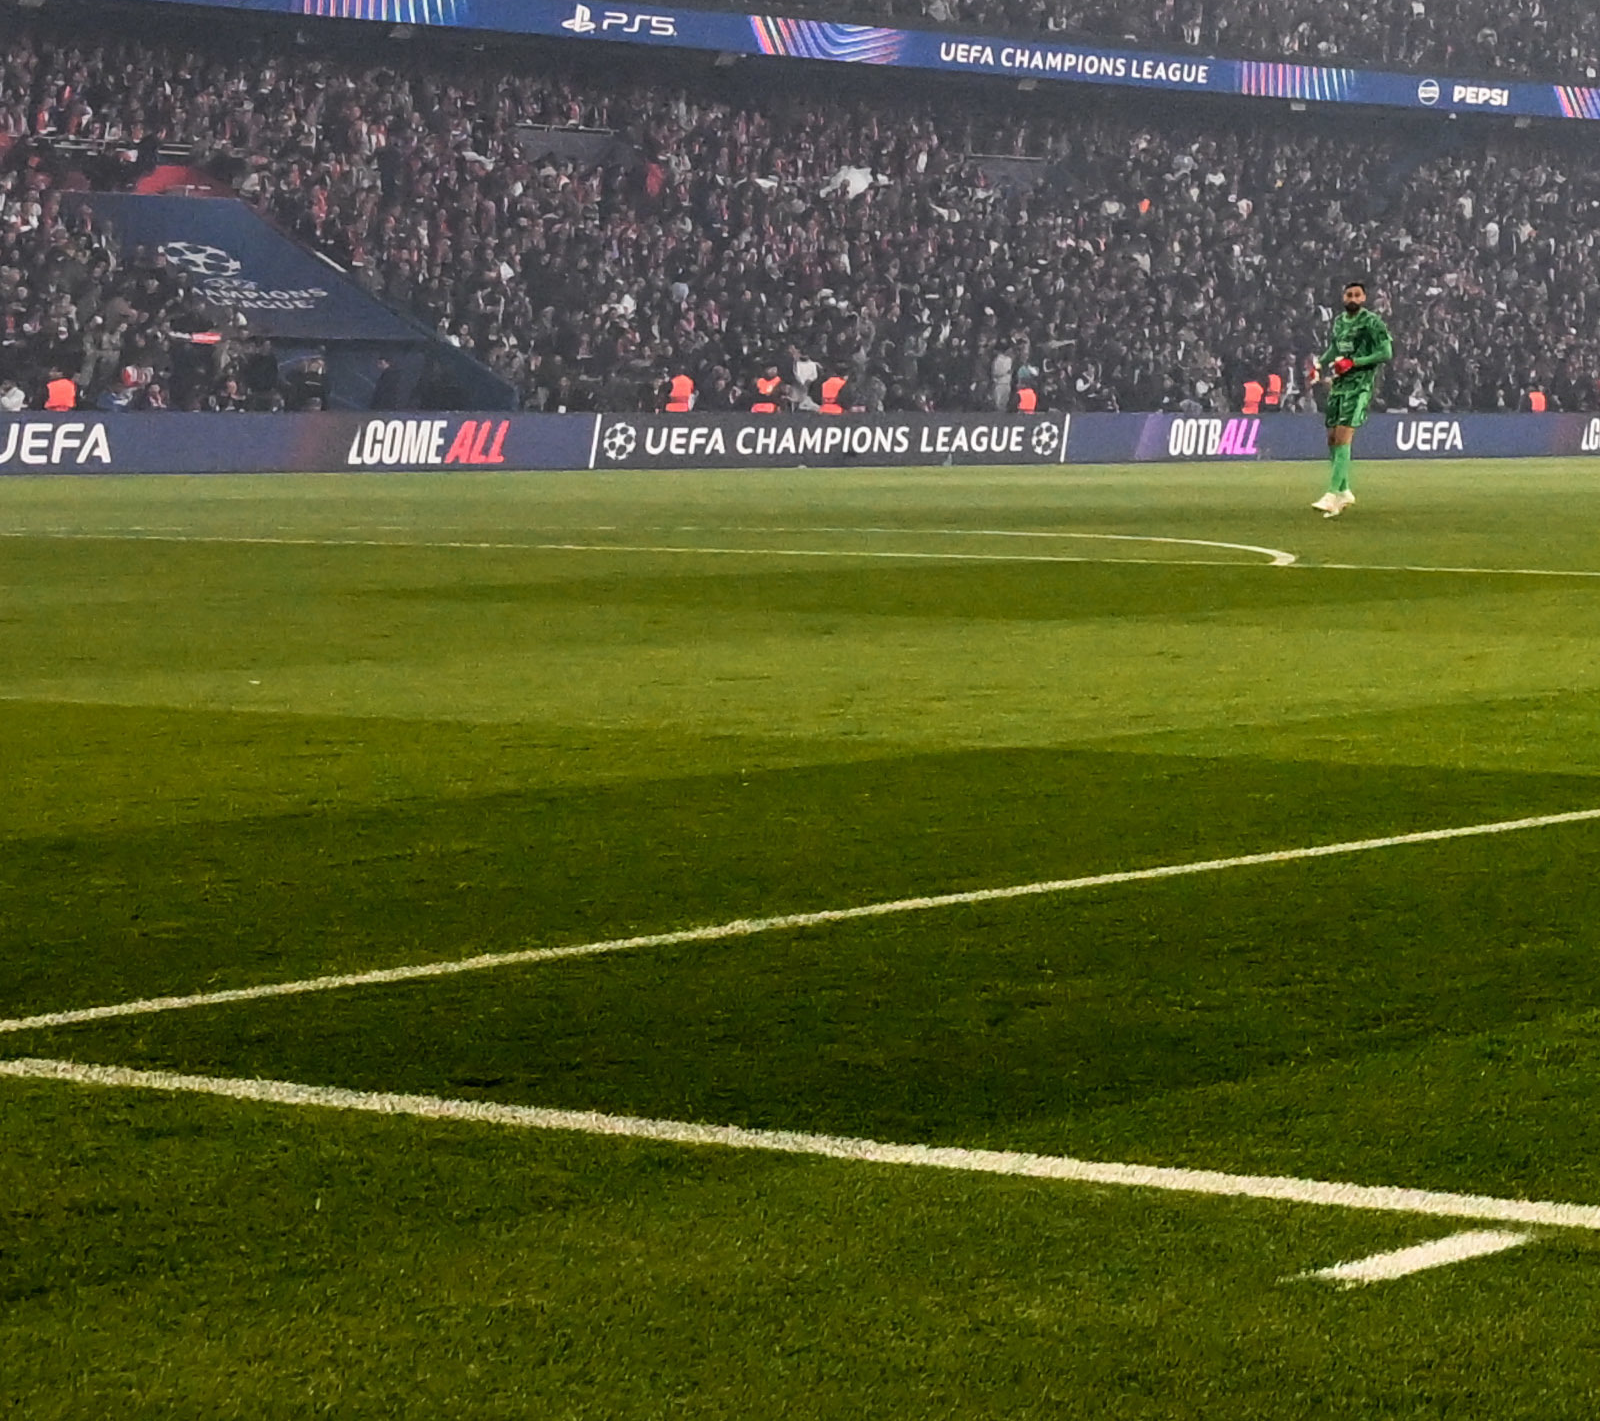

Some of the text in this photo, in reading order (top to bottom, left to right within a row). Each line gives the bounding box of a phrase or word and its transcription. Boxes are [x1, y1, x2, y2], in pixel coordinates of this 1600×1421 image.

[602, 11, 677, 36] PS5
[940, 42, 1209, 84] UEFA CHAMPIONS LEAGUE
[1452, 85, 1509, 107] PEPSI
[444, 419, 510, 464] ALL
[645, 426, 1025, 455] UEFA CHAMPIONS LEAGUE
[1396, 421, 1463, 451] UEFA
